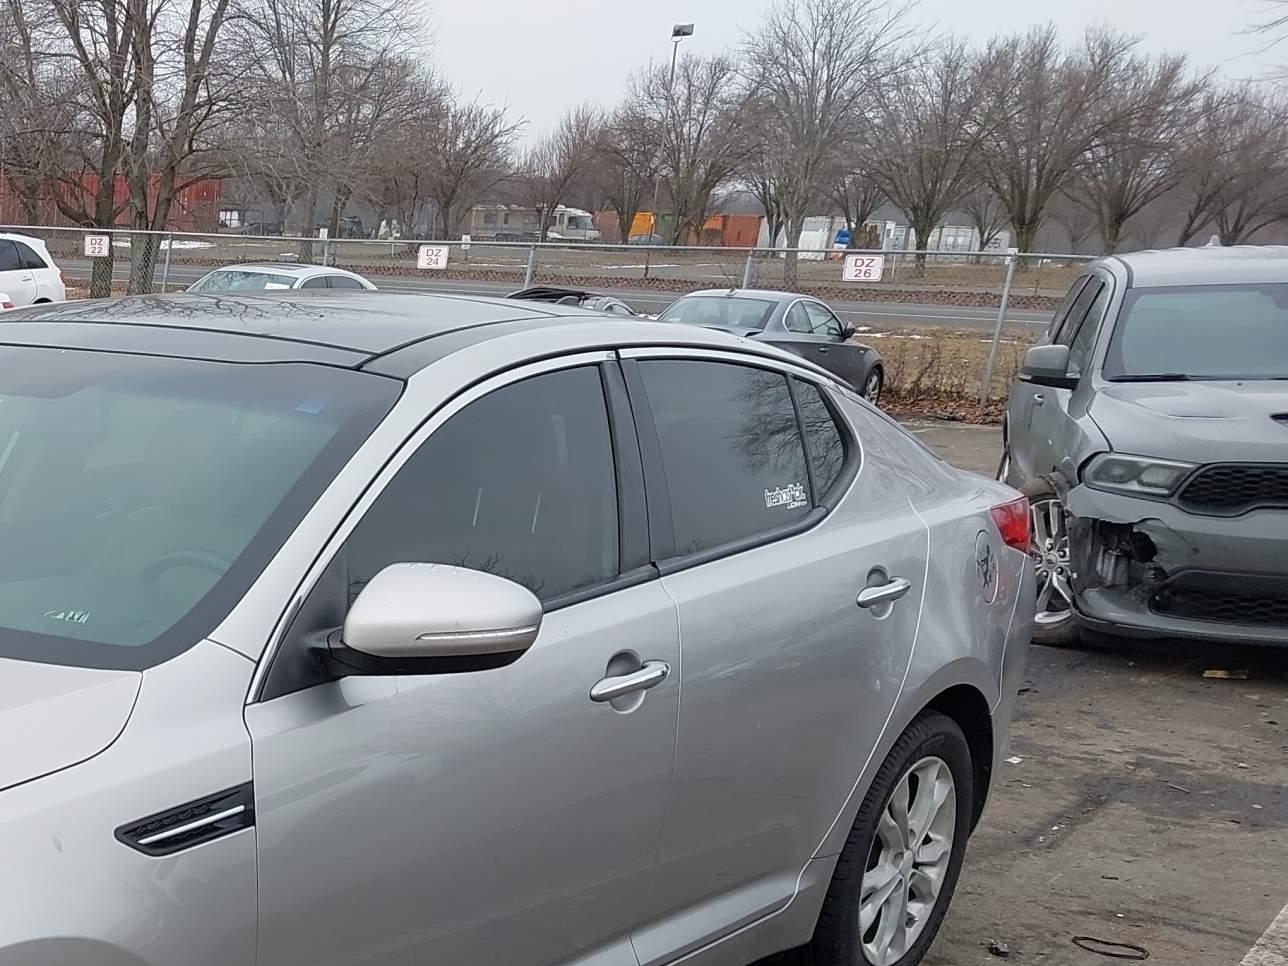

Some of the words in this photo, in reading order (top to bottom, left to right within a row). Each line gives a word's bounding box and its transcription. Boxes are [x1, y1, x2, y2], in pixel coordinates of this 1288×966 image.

[90, 238, 104, 246] DZ
[90, 246, 103, 254] 22
[425, 248, 442, 257] DZ
[426, 257, 439, 265] 24
[854, 258, 875, 268] DZ
[854, 268, 872, 278] 26
